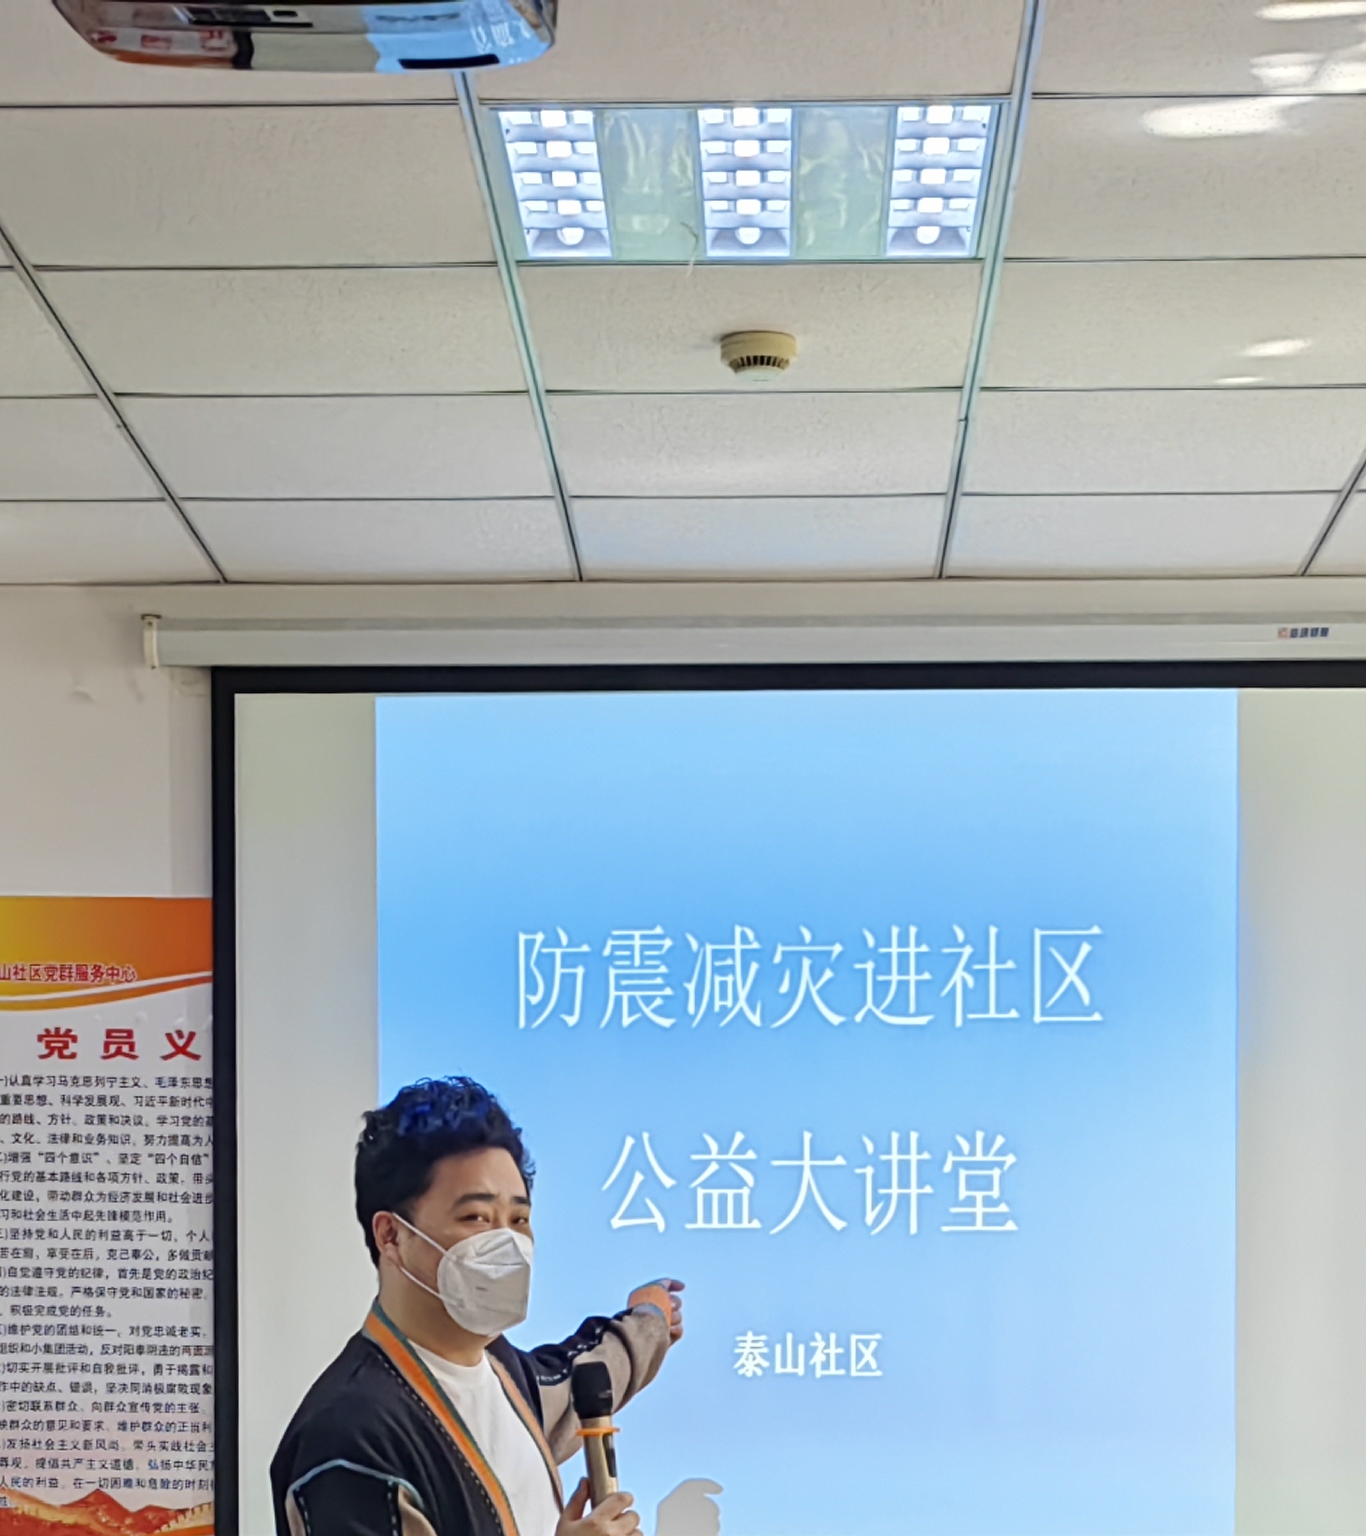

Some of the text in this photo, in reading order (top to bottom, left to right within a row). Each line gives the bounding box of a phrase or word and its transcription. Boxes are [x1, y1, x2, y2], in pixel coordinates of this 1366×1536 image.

[516, 924, 1104, 1029] 防震减灾进社区
[37, 1027, 201, 1061] 党员义
[601, 1130, 1019, 1235] 公益大讲堂
[733, 1329, 883, 1378] 泰山社区
